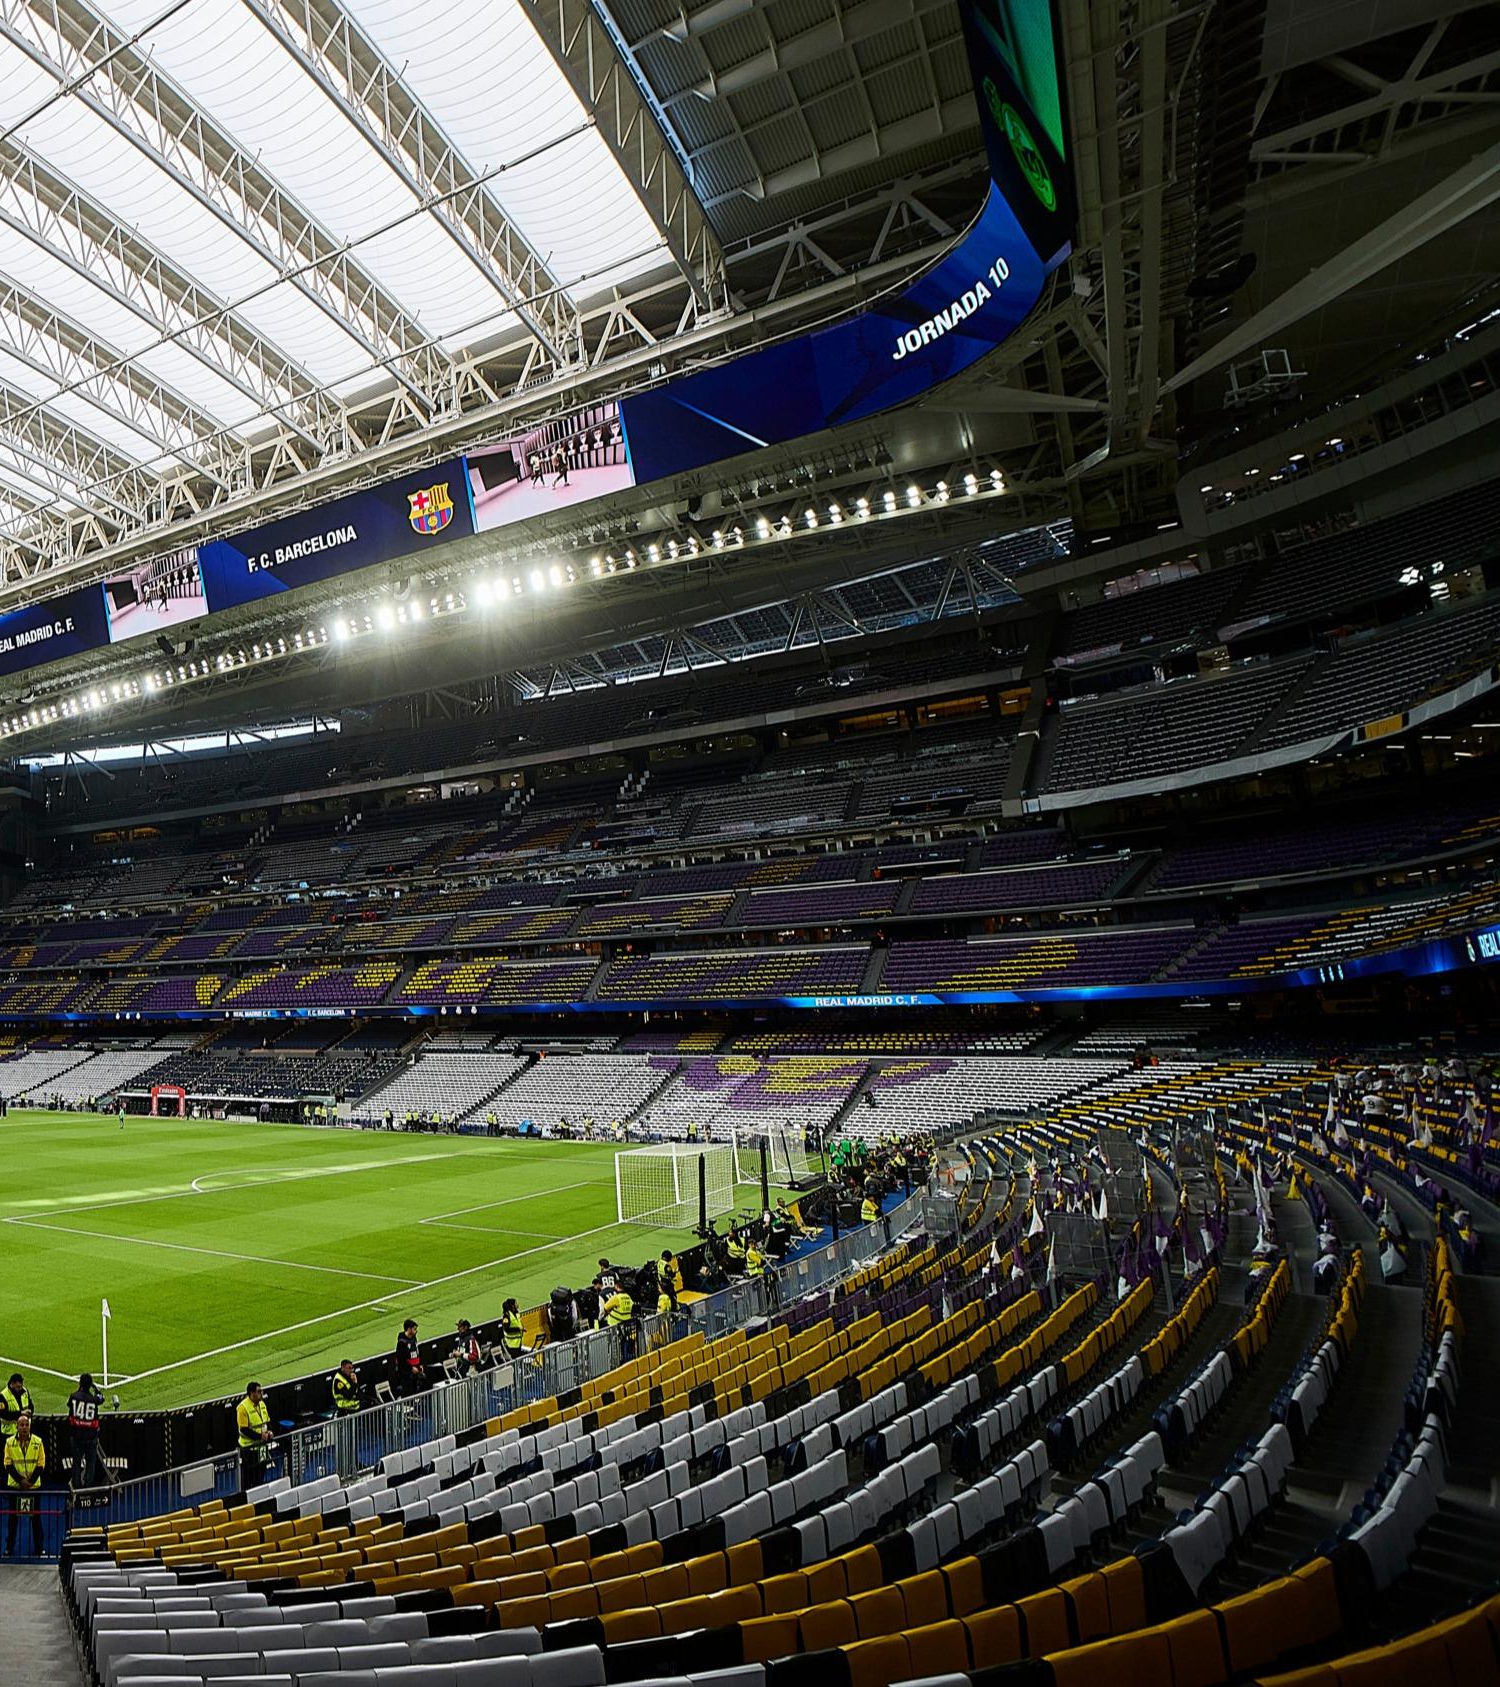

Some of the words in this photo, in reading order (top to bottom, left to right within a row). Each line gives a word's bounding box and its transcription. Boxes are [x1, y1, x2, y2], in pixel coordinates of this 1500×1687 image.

[892, 281, 991, 360] JORNADA
[988, 257, 1010, 288] 10
[247, 557, 259, 573] F.
[260, 553, 273, 569] C.
[275, 525, 357, 565] BARCELONA
[15, 624, 53, 648] MADRID
[54, 621, 65, 635] C.
[65, 617, 75, 632] F.
[815, 997, 844, 1006] REAL
[846, 996, 892, 1006] MADRID
[895, 995, 908, 1004] C.
[910, 995, 922, 1004] F.
[72, 1399, 96, 1420] 146
